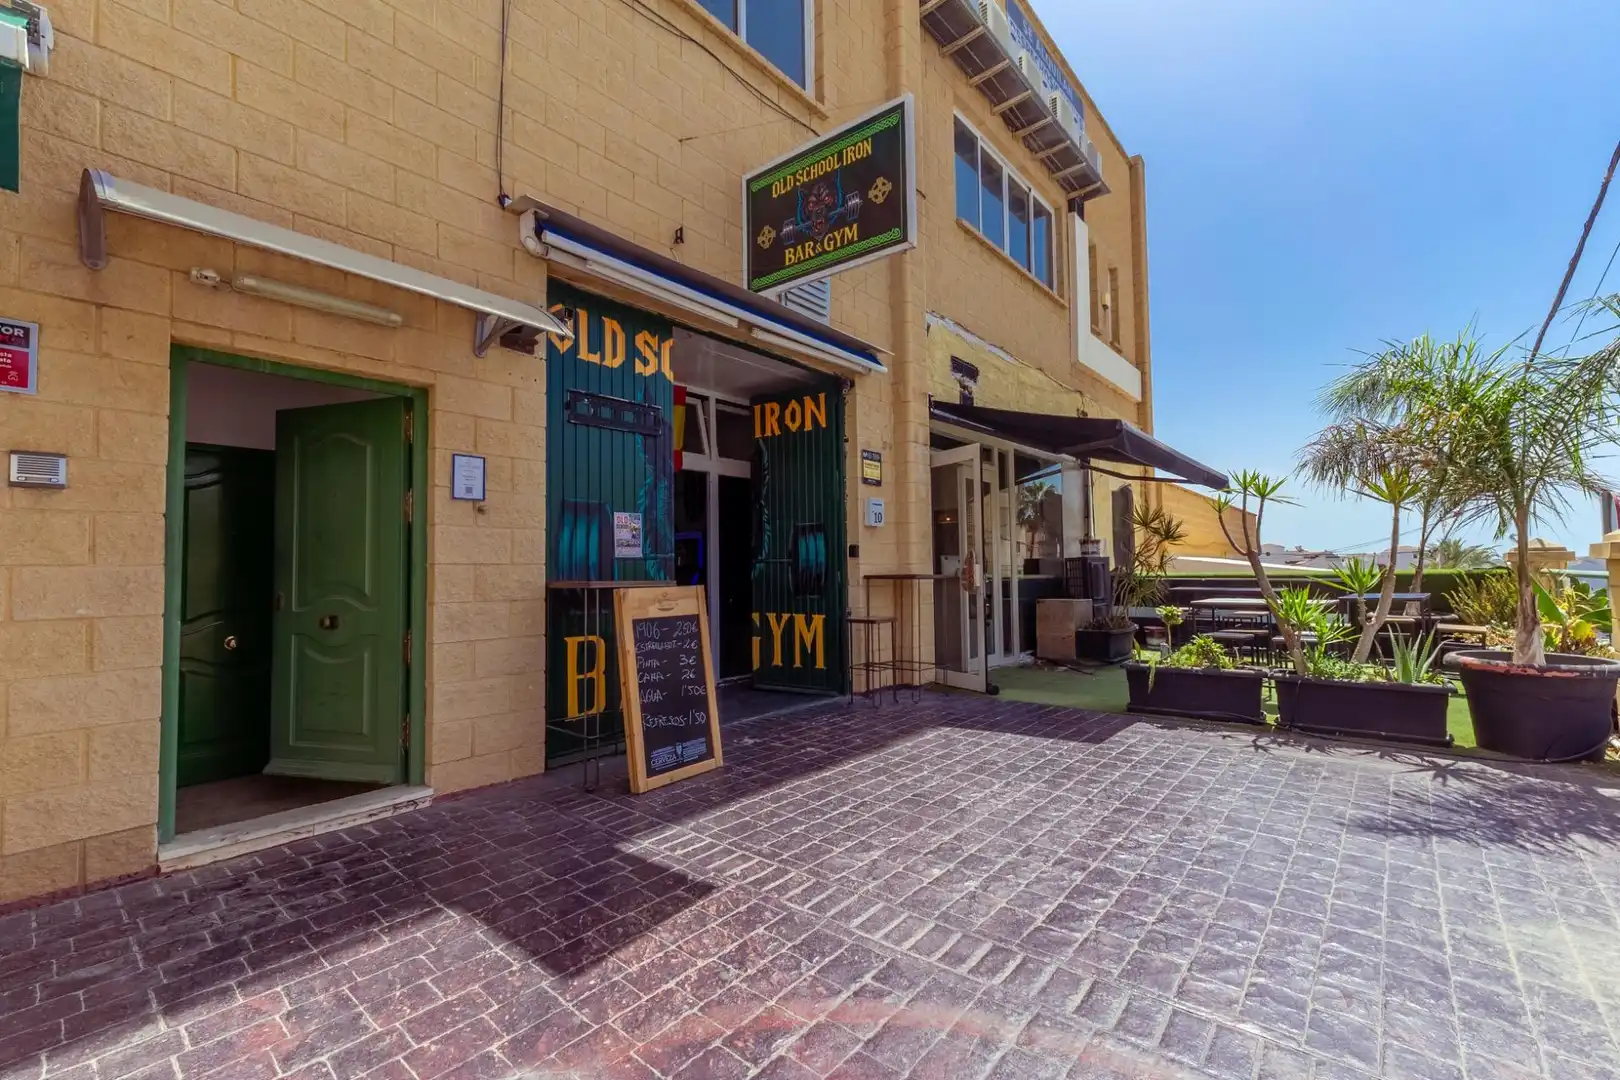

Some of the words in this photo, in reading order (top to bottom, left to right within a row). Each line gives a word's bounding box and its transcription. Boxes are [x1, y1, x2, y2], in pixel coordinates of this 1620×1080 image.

[772, 175, 794, 199] OLD
[795, 153, 841, 186] SCHOOL
[843, 137, 873, 166] IRON
[0, 325, 24, 338] OR
[753, 392, 827, 439] IRON
[873, 512, 883, 524] 10
[563, 635, 607, 720] B
